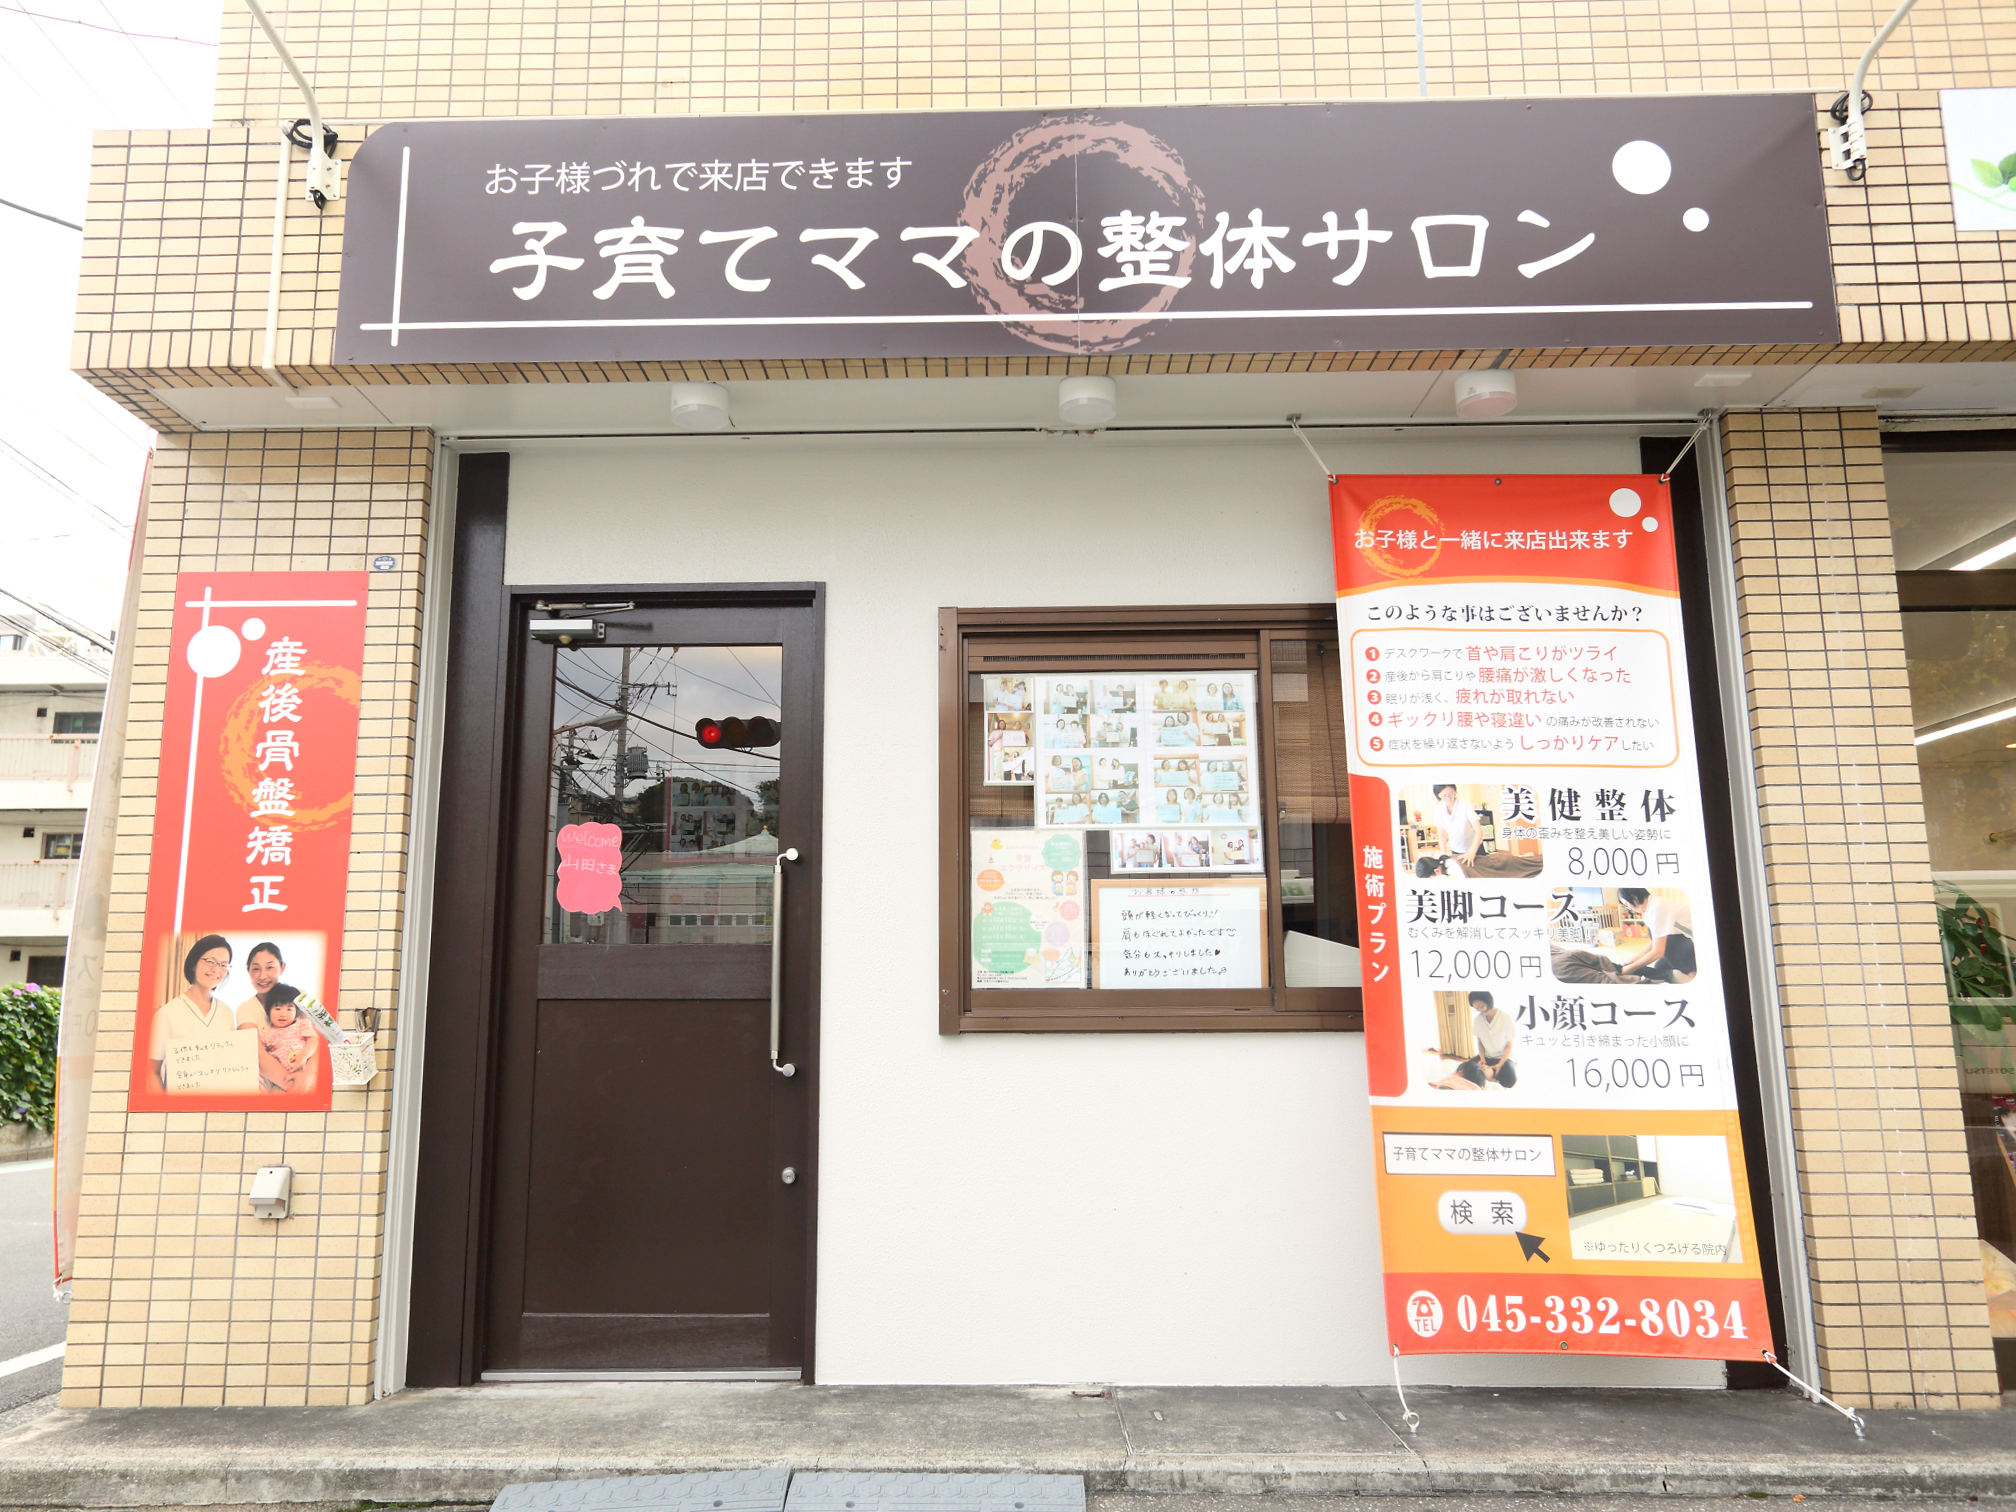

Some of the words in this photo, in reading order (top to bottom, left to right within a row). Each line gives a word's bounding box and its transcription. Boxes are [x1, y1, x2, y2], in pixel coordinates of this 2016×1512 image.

[484, 155, 914, 196] お子様づれで来店できます
[488, 208, 1596, 301] 子育てママの整体サロン
[1353, 528, 1634, 551] お子様と一緒に来店出来ます
[1366, 603, 1643, 623] このような事はございませんか？
[241, 635, 308, 913] 産後骨盤矯正
[1501, 787, 1677, 823] 美健整体
[1501, 827, 1672, 841] 身体の歪みを整え美しい姿勢に
[562, 853, 617, 876] 山田さま
[1000, 864, 1046, 872] エクササイズ
[1567, 847, 1648, 880] 8,000
[1656, 853, 1680, 875] 円
[1362, 846, 1390, 983] 施術プラン
[1405, 889, 1580, 924] 美脚コース
[1411, 949, 1511, 983] 12,000
[1520, 955, 1542, 979] 円
[1514, 995, 1697, 1031] 小顔コース
[1522, 1034, 1690, 1048] キュッと引き締まった小顔に
[1567, 1058, 1671, 1092] 16,000
[1679, 1064, 1705, 1087] 円
[1393, 1146, 1541, 1162] 子育てママの整体サロン
[1450, 1199, 1514, 1225] 検索
[1414, 1318, 1437, 1332] TEL
[1457, 1294, 1749, 1340] 045-332-8034
